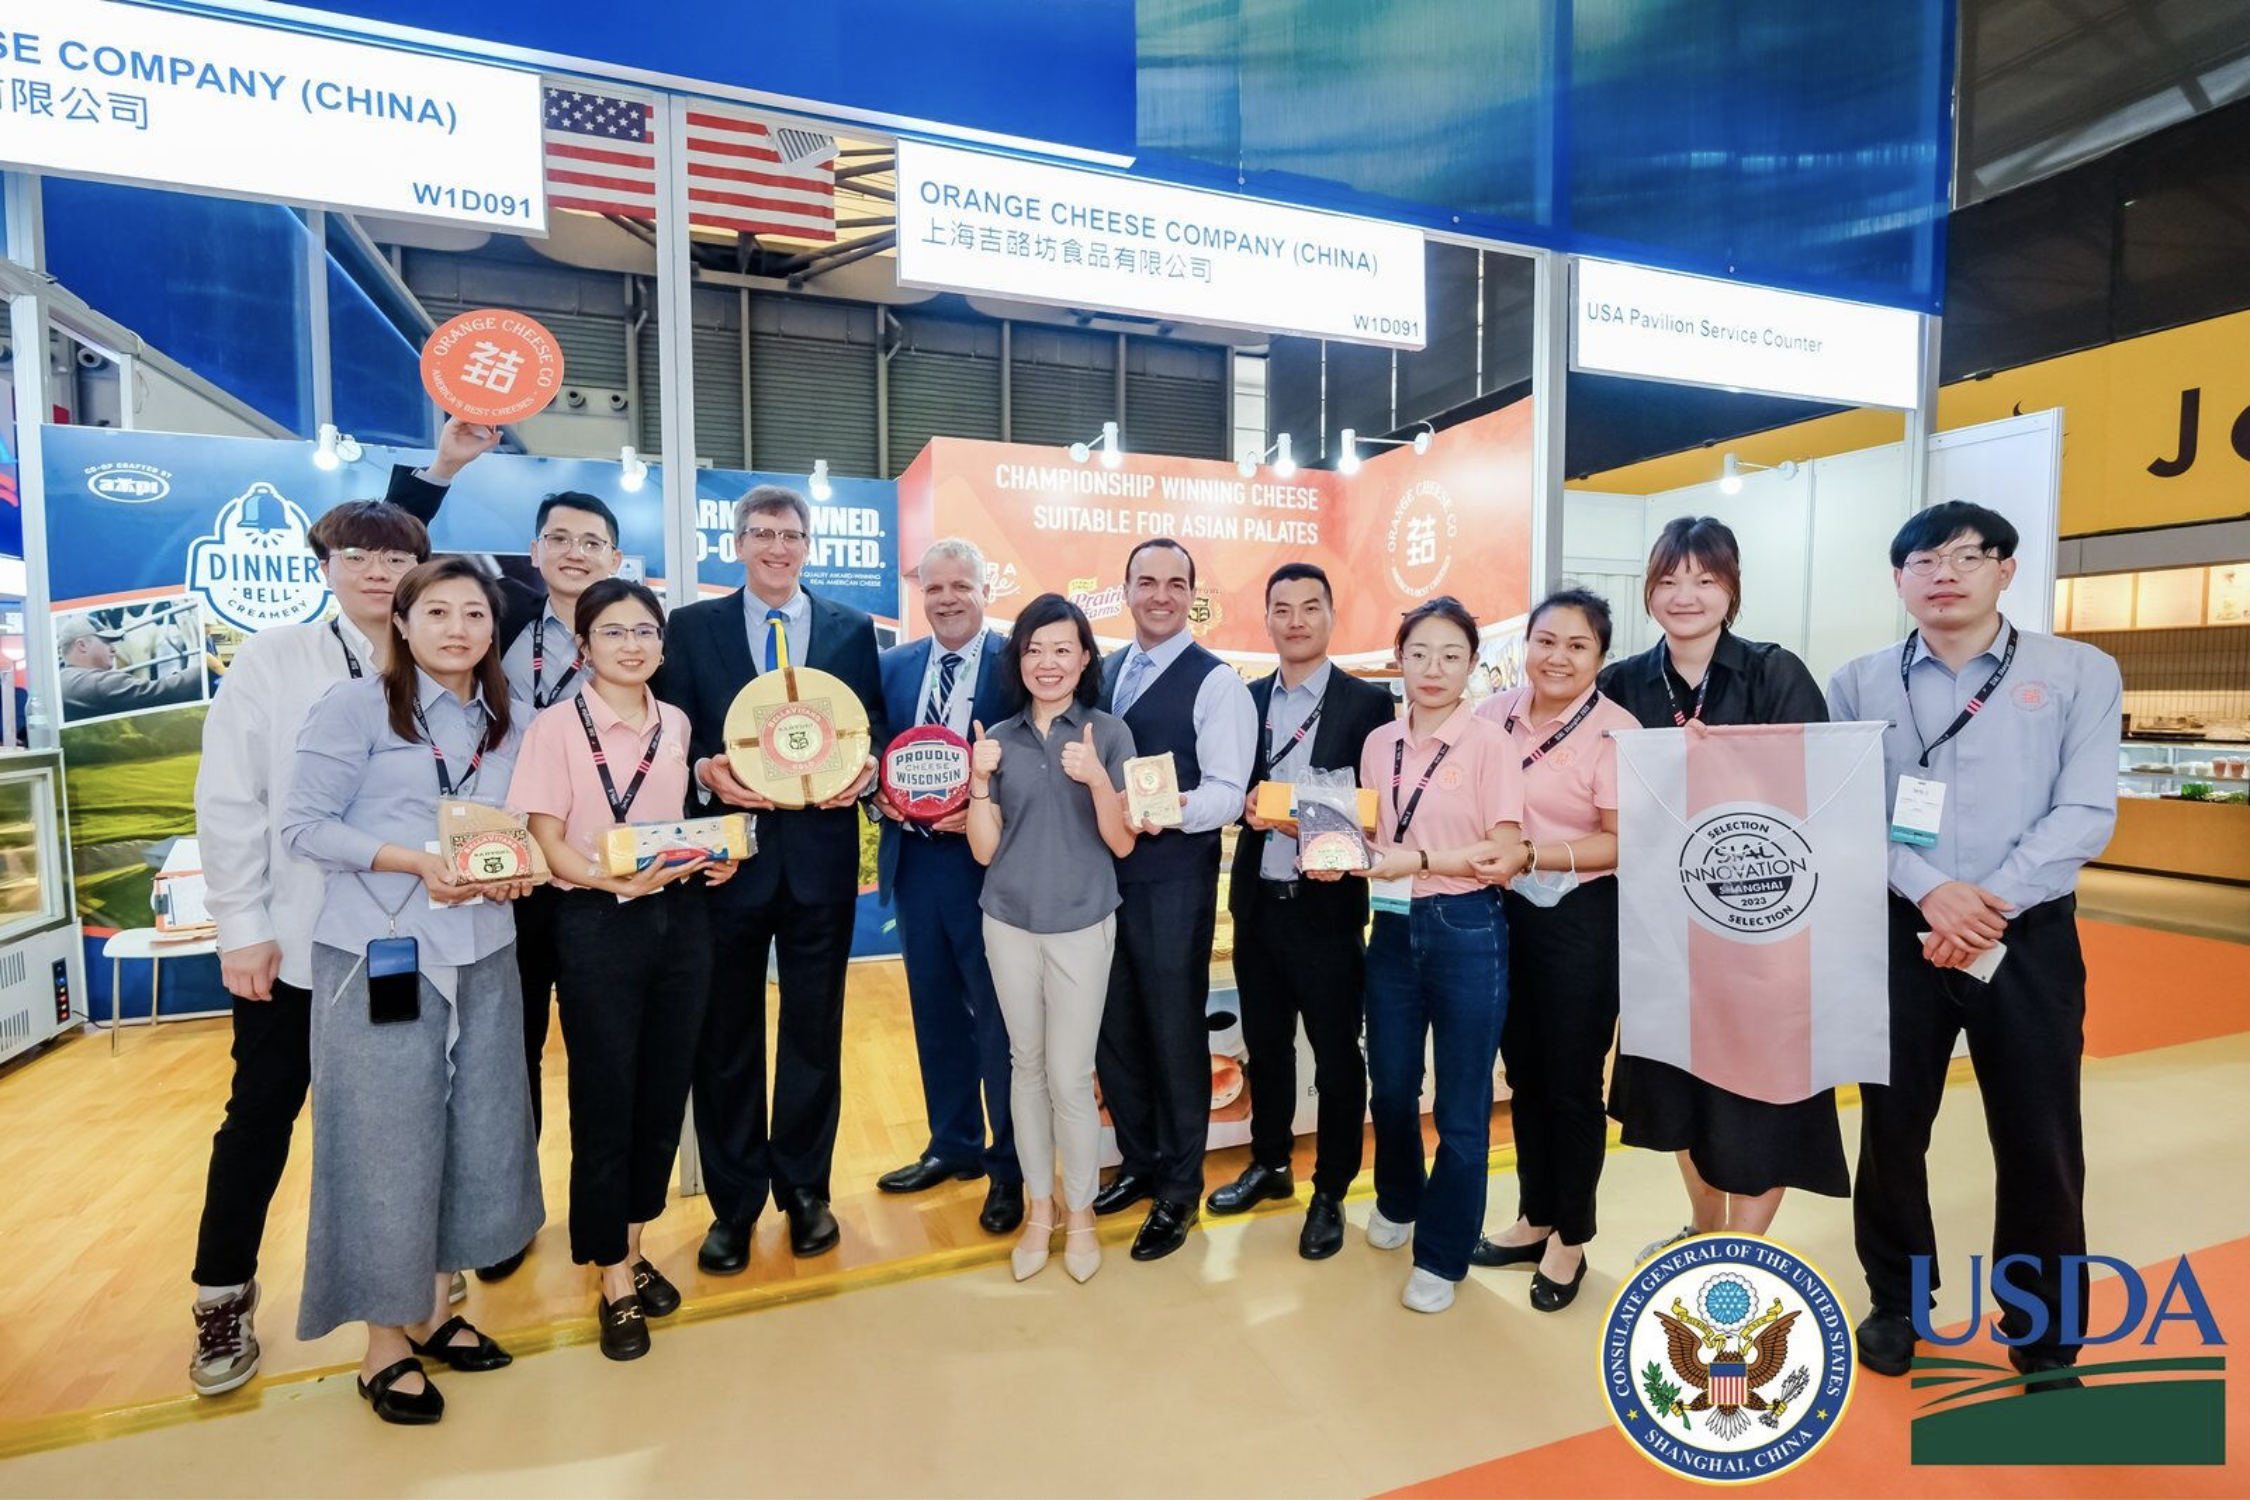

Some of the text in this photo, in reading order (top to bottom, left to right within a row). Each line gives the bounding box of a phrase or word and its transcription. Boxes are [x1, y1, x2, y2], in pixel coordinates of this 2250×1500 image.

[58, 41, 286, 102] COMPANY
[301, 79, 457, 135] (CHINA)
[0, 78, 148, 130] 限公司
[413, 182, 531, 219] W1D091
[920, 180, 1379, 279] ORANGE CHEESE COMPANY (CHINA)
[1353, 314, 1419, 337] W1D091
[1587, 302, 1823, 353] USA Pavilion Service Counter
[433, 317, 555, 388] ORANGE CHEESE CO
[995, 463, 1319, 511] CHAMPIONSHIP WINNING CHEESE
[1033, 504, 1319, 545] SUITABLE FOR ASIAN PALATES
[1387, 480, 1458, 552] ORANGE CHEESE CO
[209, 552, 322, 584] DINNER
[242, 587, 292, 603] BELL
[227, 599, 308, 620] CREAMERY
[895, 750, 960, 765] PROUDLY
[905, 762, 950, 772] CHEESE
[896, 768, 961, 785] WISCONSIN
[1707, 820, 1770, 839] SELECTION
[1680, 857, 1807, 884] INNOVATION
[1719, 880, 1784, 895] SHANGHAI
[1741, 896, 1767, 907] 2023
[1728, 905, 1794, 926] SELECTION
